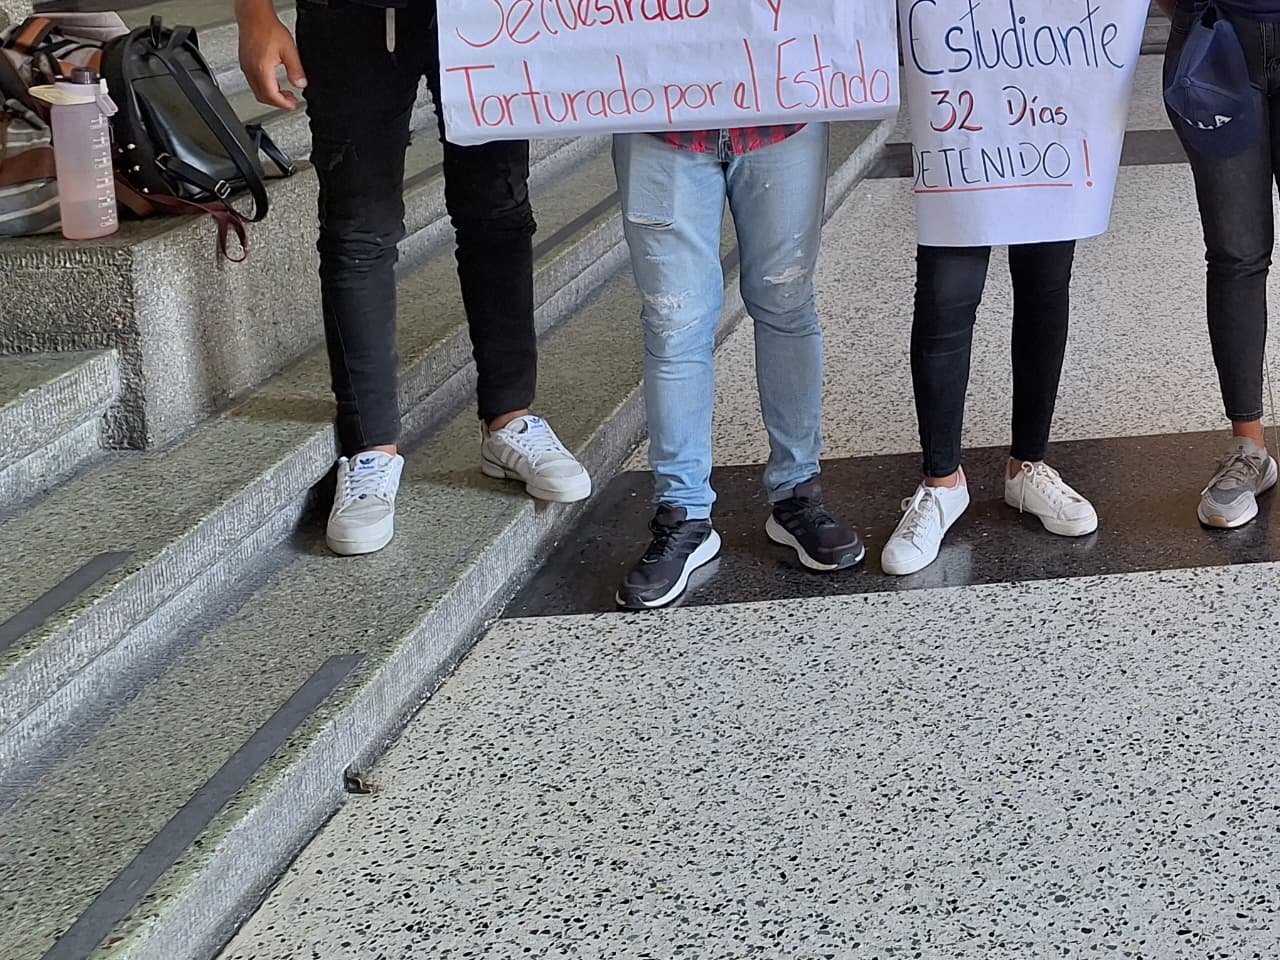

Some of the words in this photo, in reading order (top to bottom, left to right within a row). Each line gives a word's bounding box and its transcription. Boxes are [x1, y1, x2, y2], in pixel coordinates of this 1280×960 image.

[445, 55, 655, 127] Torturado
[665, 78, 724, 124] por
[733, 38, 761, 113] el
[776, 33, 891, 111] Estado
[930, 88, 984, 133] 32
[1001, 85, 1069, 128] Días
